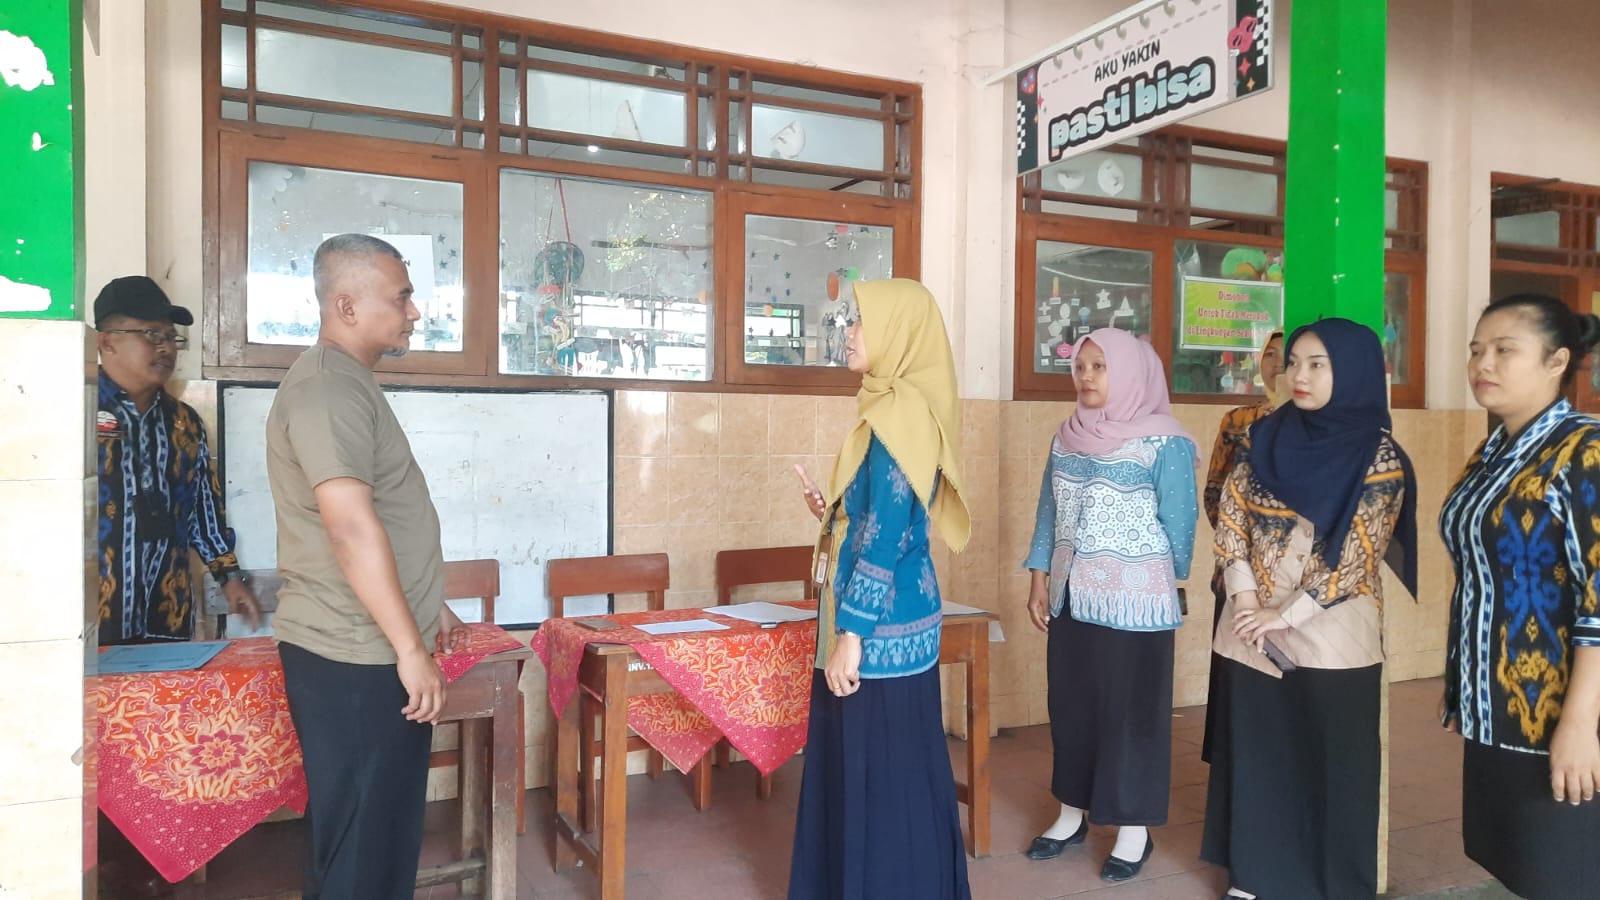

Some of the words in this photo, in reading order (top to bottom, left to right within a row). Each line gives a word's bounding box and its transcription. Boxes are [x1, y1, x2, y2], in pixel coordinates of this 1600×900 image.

[1094, 61, 1118, 83] AKU
[1121, 39, 1161, 72] YAKIN
[1049, 76, 1132, 162] pasti
[1132, 57, 1215, 123] bisa
